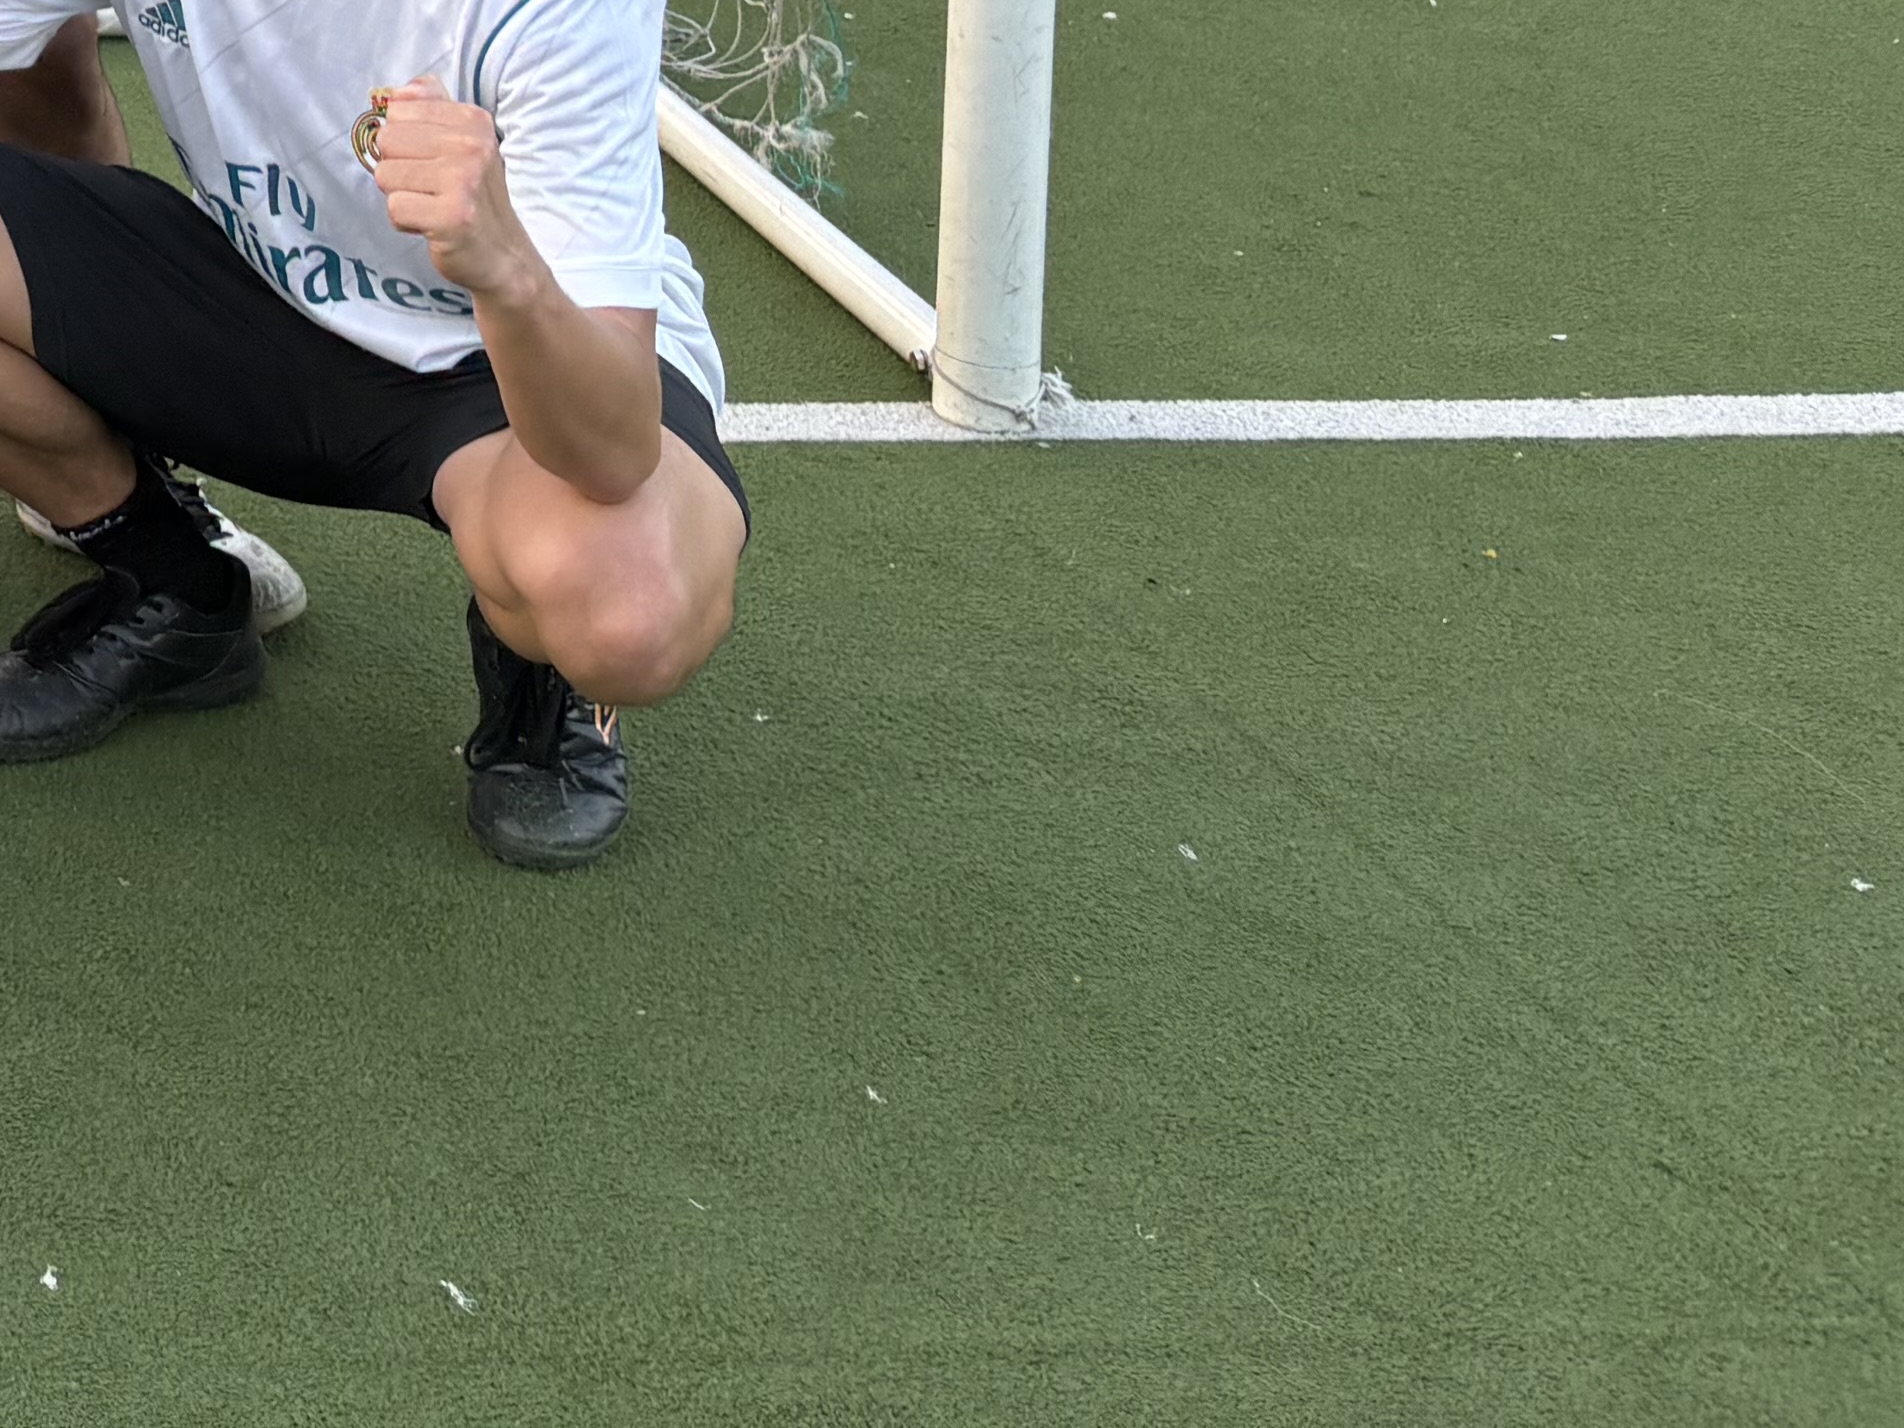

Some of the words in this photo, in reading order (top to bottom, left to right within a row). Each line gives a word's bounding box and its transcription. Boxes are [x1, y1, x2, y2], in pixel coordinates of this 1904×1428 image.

[138, 13, 191, 50] adida
[224, 161, 316, 232] Fly
[192, 174, 475, 315] mirates
